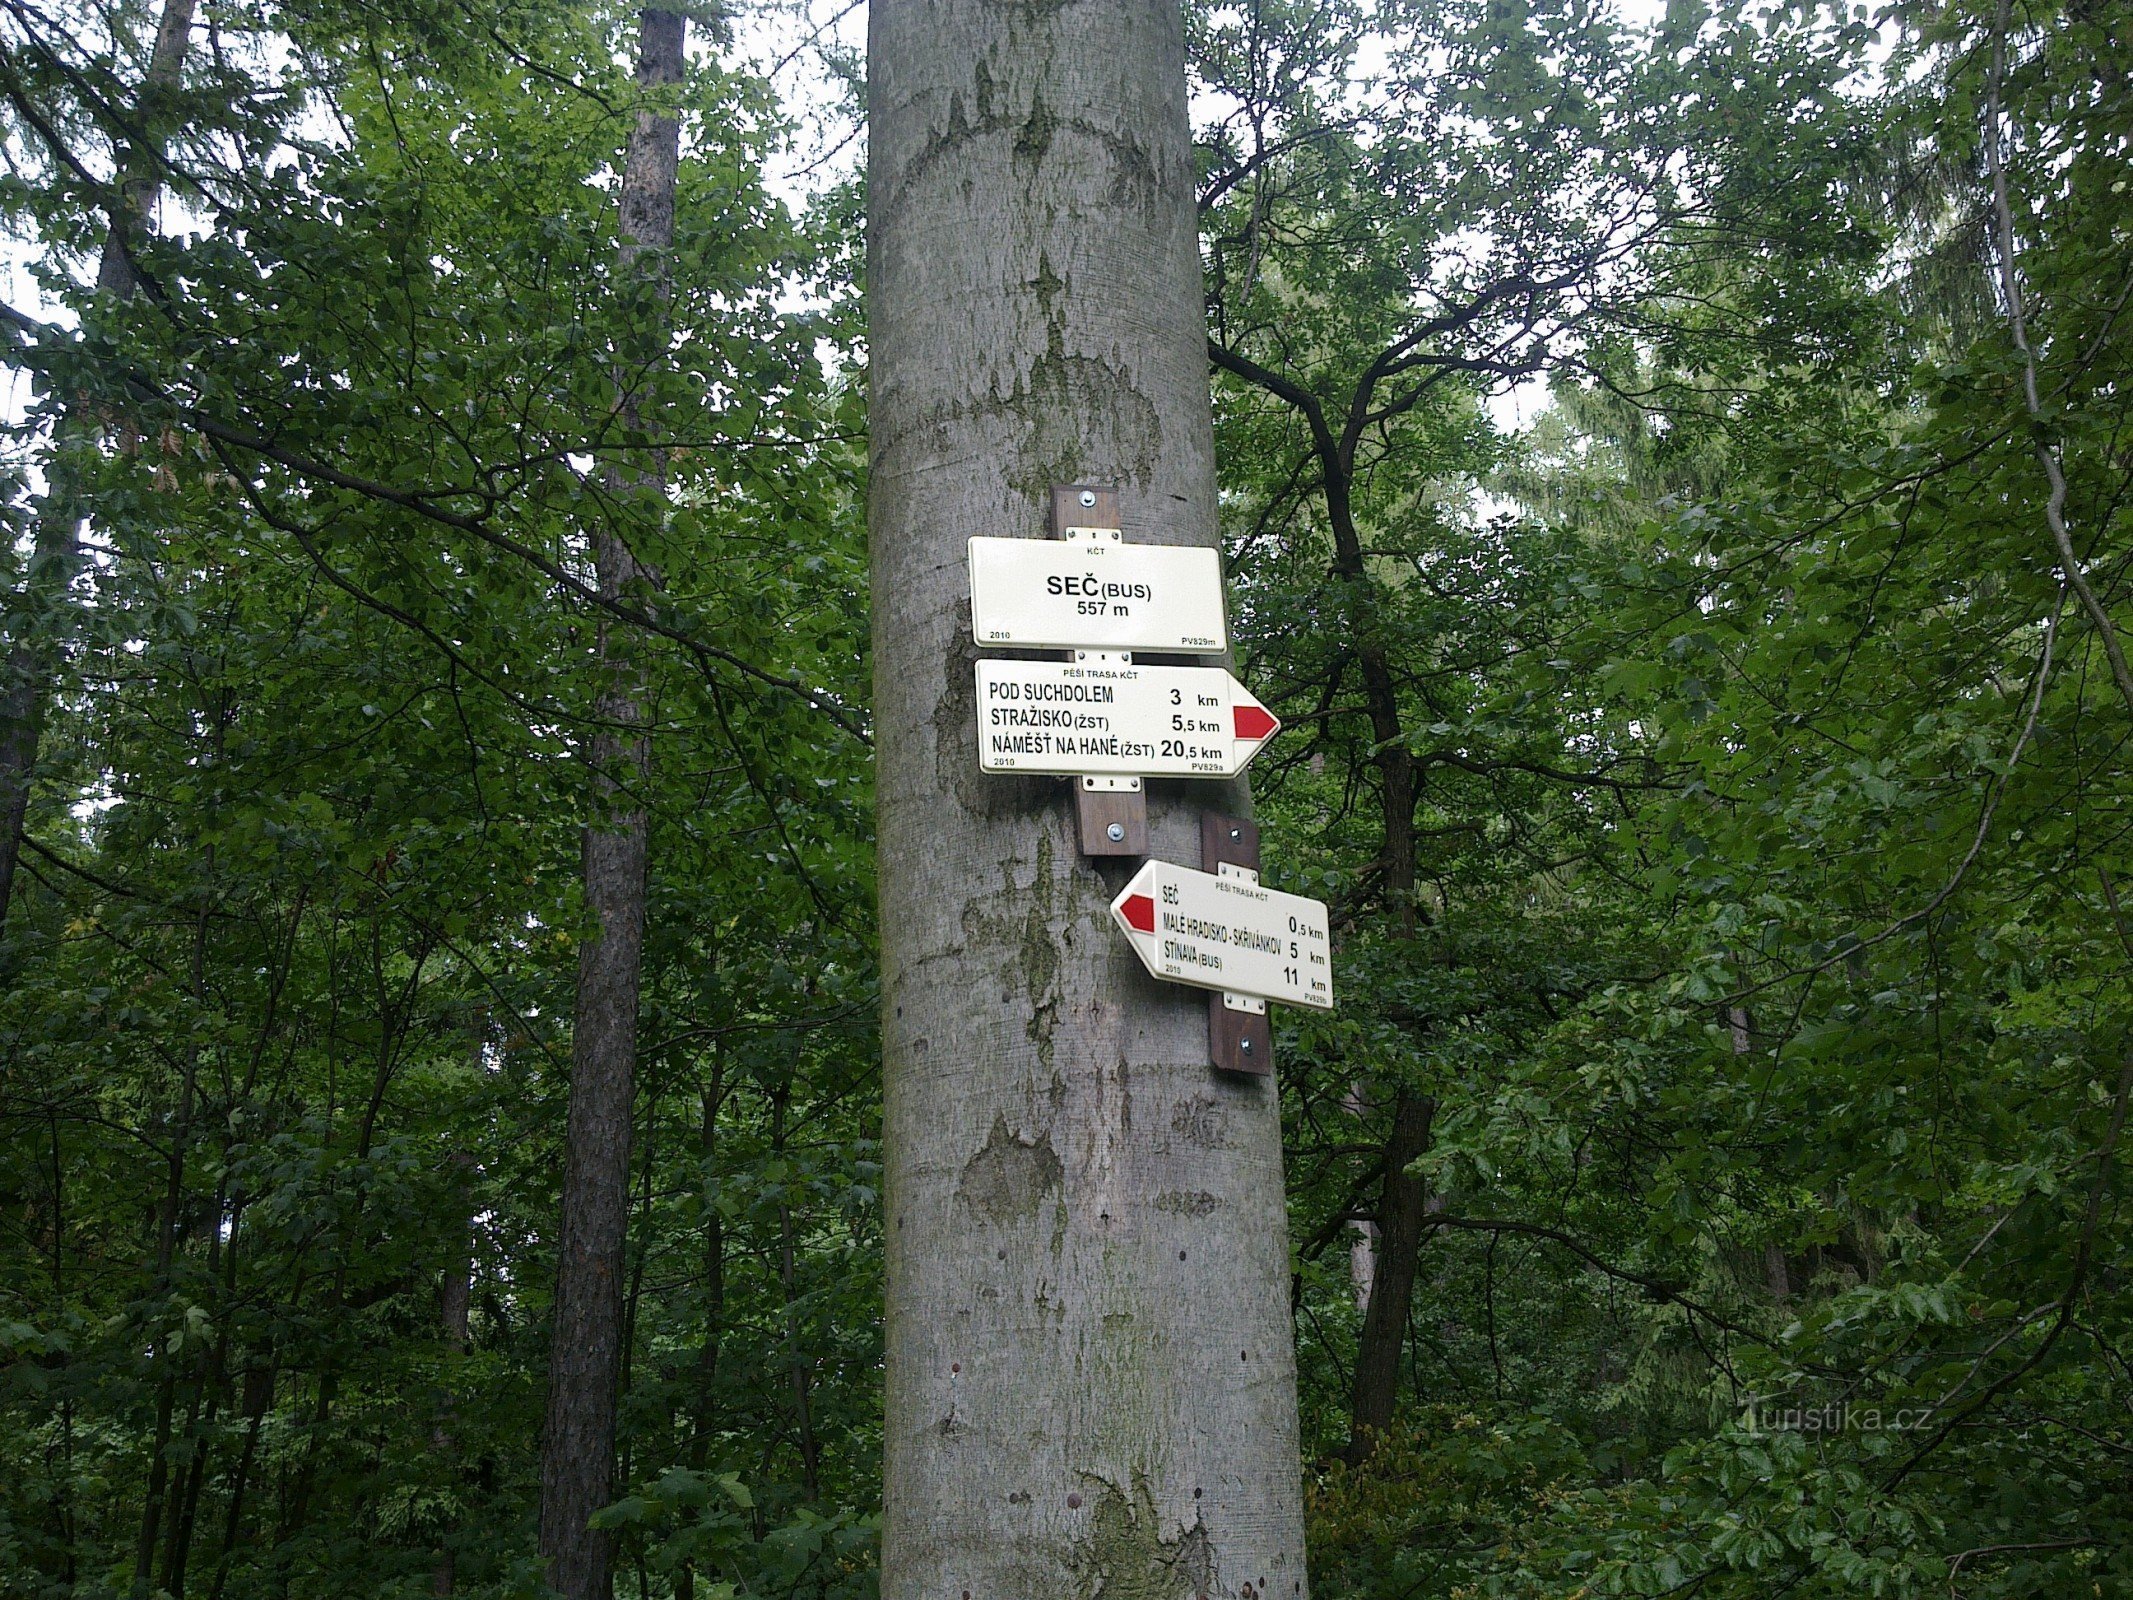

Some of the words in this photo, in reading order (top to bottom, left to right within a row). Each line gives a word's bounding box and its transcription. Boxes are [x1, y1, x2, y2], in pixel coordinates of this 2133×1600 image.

[1087, 546, 1105, 555] KČT
[1077, 602, 1106, 616] 557
[1113, 605, 1129, 616] m
[990, 631, 1010, 639] 2010
[1181, 637, 1216, 646] PV829m
[1087, 670, 1118, 679] TRASA
[1120, 670, 1138, 679] KČT
[990, 682, 1020, 700] POD
[1024, 683, 1113, 703] SUCHDOLEM
[1170, 689, 1181, 705] 3
[1197, 694, 1218, 706] km
[1172, 715, 1195, 733] 5,5
[1199, 720, 1220, 732] km
[992, 731, 1052, 754] NÁMĚŠŤ
[1057, 737, 1076, 754] NA
[1161, 740, 1197, 759] 20,5
[1201, 747, 1222, 759] km
[994, 758, 1015, 766] 2010
[1192, 763, 1224, 771] PV829a
[1232, 886, 1254, 898] TRASA
[1255, 891, 1268, 902] KČT
[1163, 883, 1179, 905] SEČ
[1289, 916, 1306, 937] 0,5
[1309, 926, 1323, 940] km
[1163, 912, 1185, 934] MALÉ
[1187, 917, 1228, 944] HRADISKO
[1233, 927, 1281, 955] SKŘIVÁNKOV
[1290, 942, 1298, 959] 5
[1310, 951, 1325, 965] km
[1166, 964, 1181, 974] 2010
[1284, 966, 1298, 985] 11
[1311, 978, 1326, 992] km
